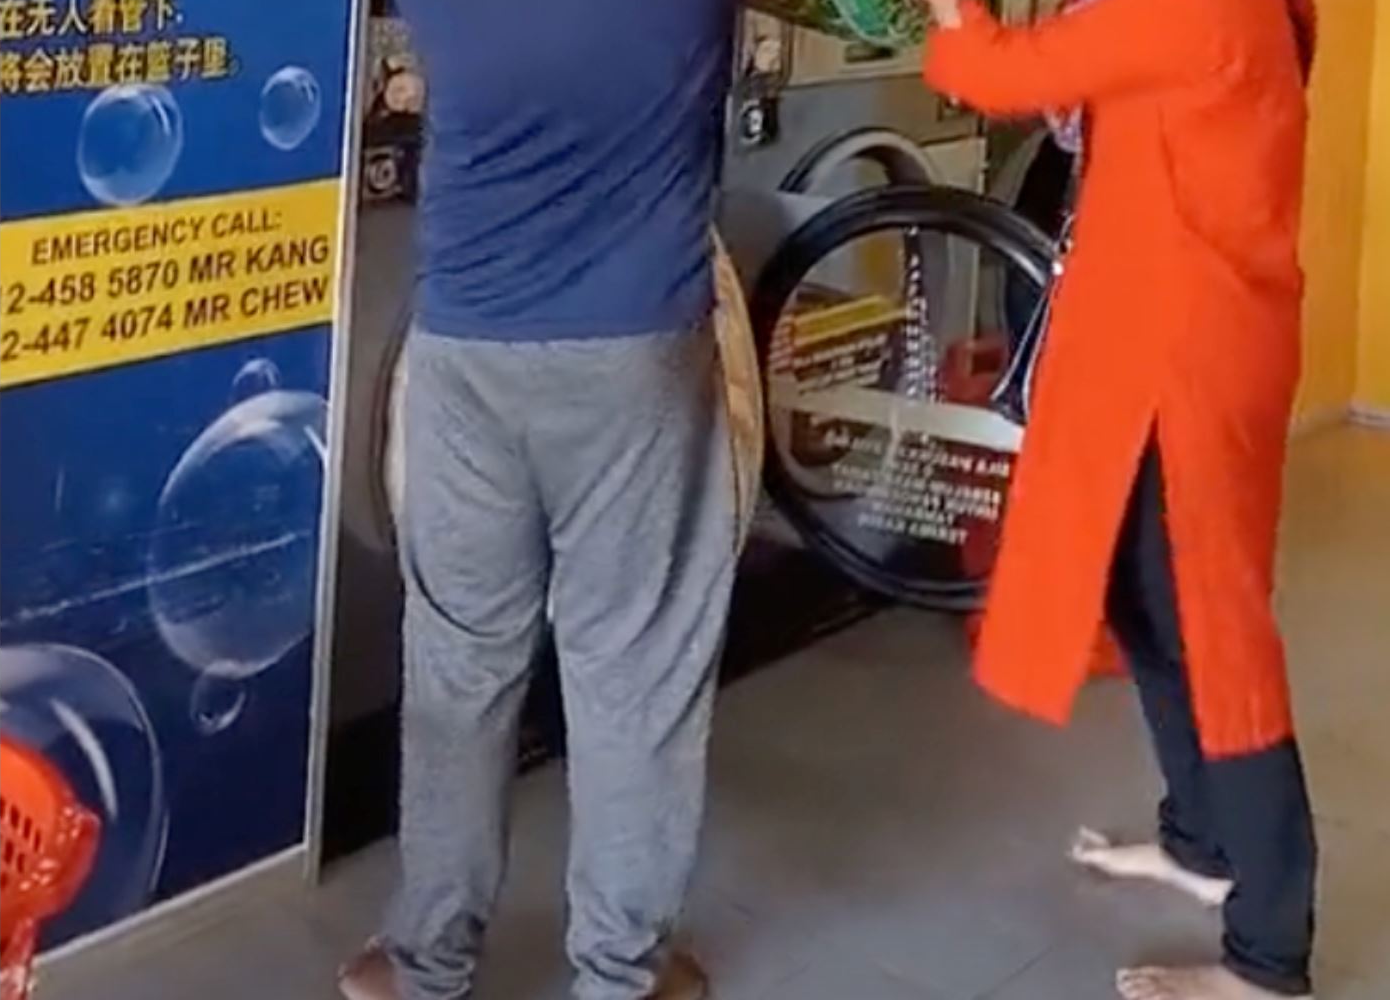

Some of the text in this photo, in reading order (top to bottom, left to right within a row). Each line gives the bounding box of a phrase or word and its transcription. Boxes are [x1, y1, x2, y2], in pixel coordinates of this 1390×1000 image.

[1, 236, 329, 315] 2-458 5870 MR KANG
[32, 210, 282, 265] EMERGENCY CALL:
[1, 277, 329, 362] 2-447 4074 MR CHEW
